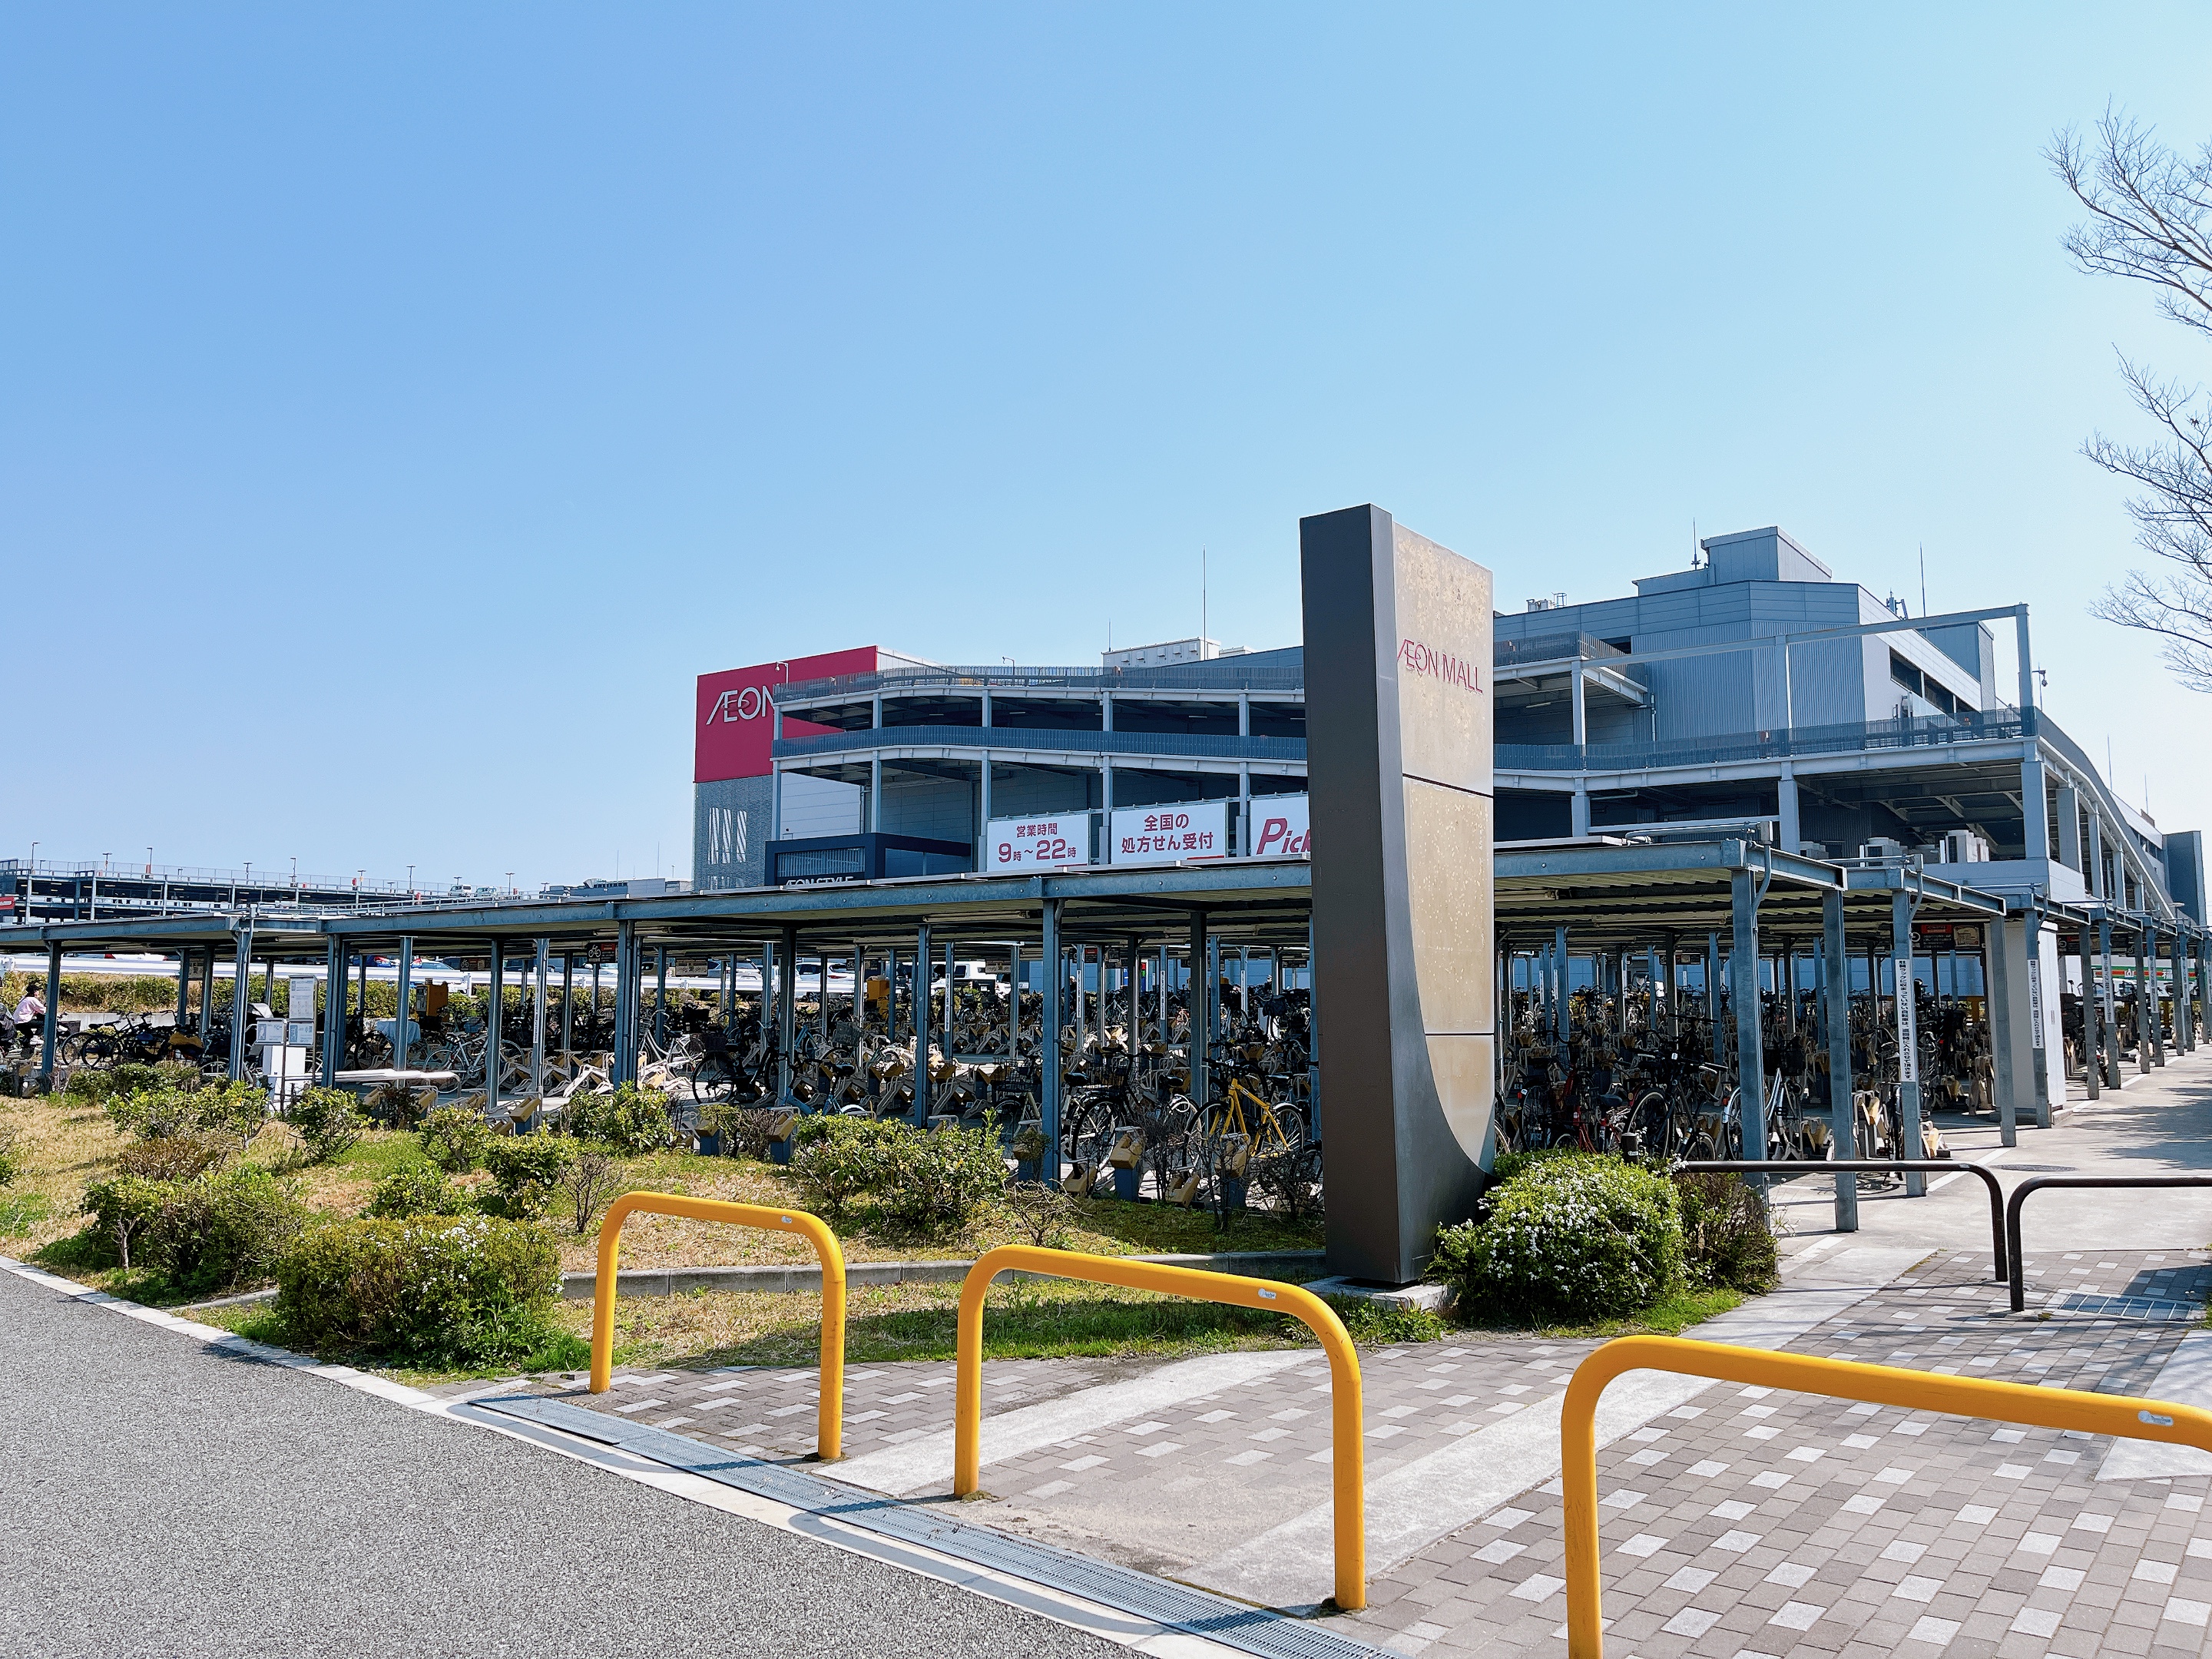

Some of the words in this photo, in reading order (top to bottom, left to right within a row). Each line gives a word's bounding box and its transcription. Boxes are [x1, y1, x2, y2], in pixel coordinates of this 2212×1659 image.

[1442, 653, 1483, 694] MALL
[1015, 823, 1058, 838] 営業時間
[1144, 813, 1190, 832] 全国の
[1121, 831, 1214, 854] 処方せん受付
